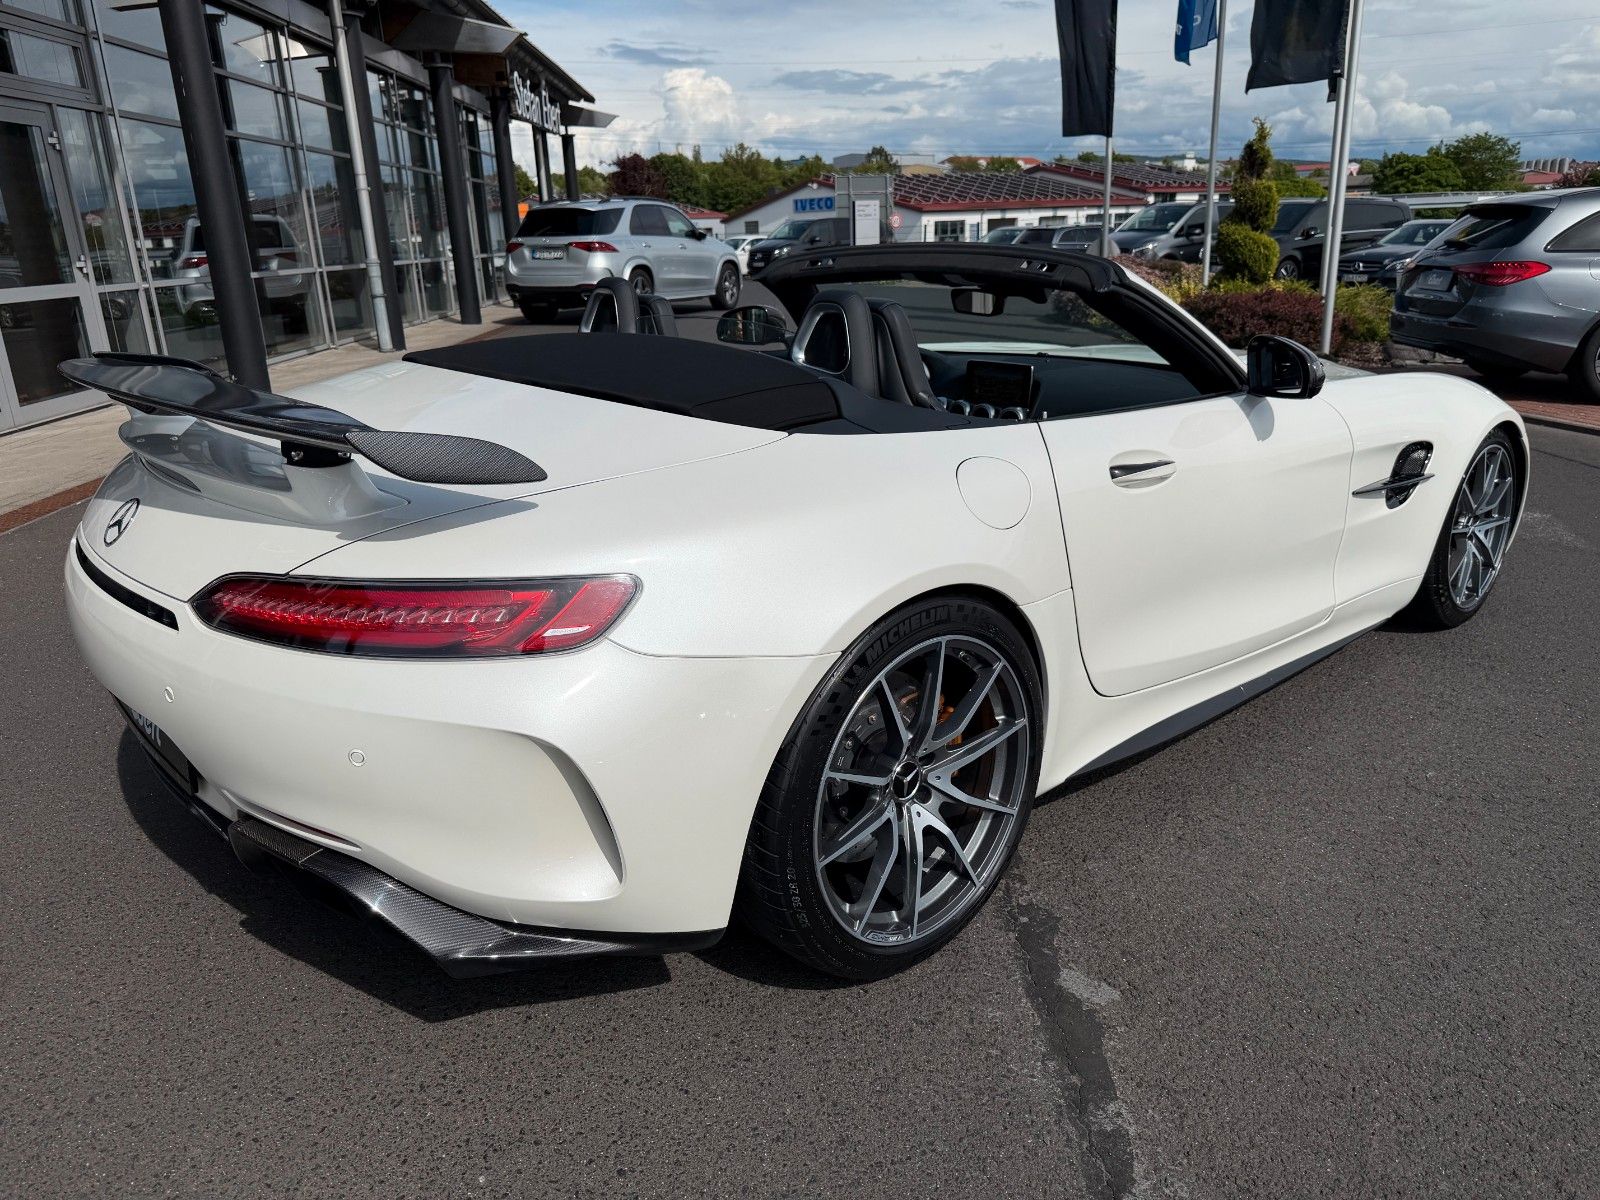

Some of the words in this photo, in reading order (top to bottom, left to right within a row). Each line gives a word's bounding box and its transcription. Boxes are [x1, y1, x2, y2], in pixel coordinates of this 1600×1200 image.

[513, 70, 542, 126] Stefan
[541, 88, 561, 135] Ebert
[794, 197, 835, 212] IVECO
[865, 604, 950, 668] MICHELIN
